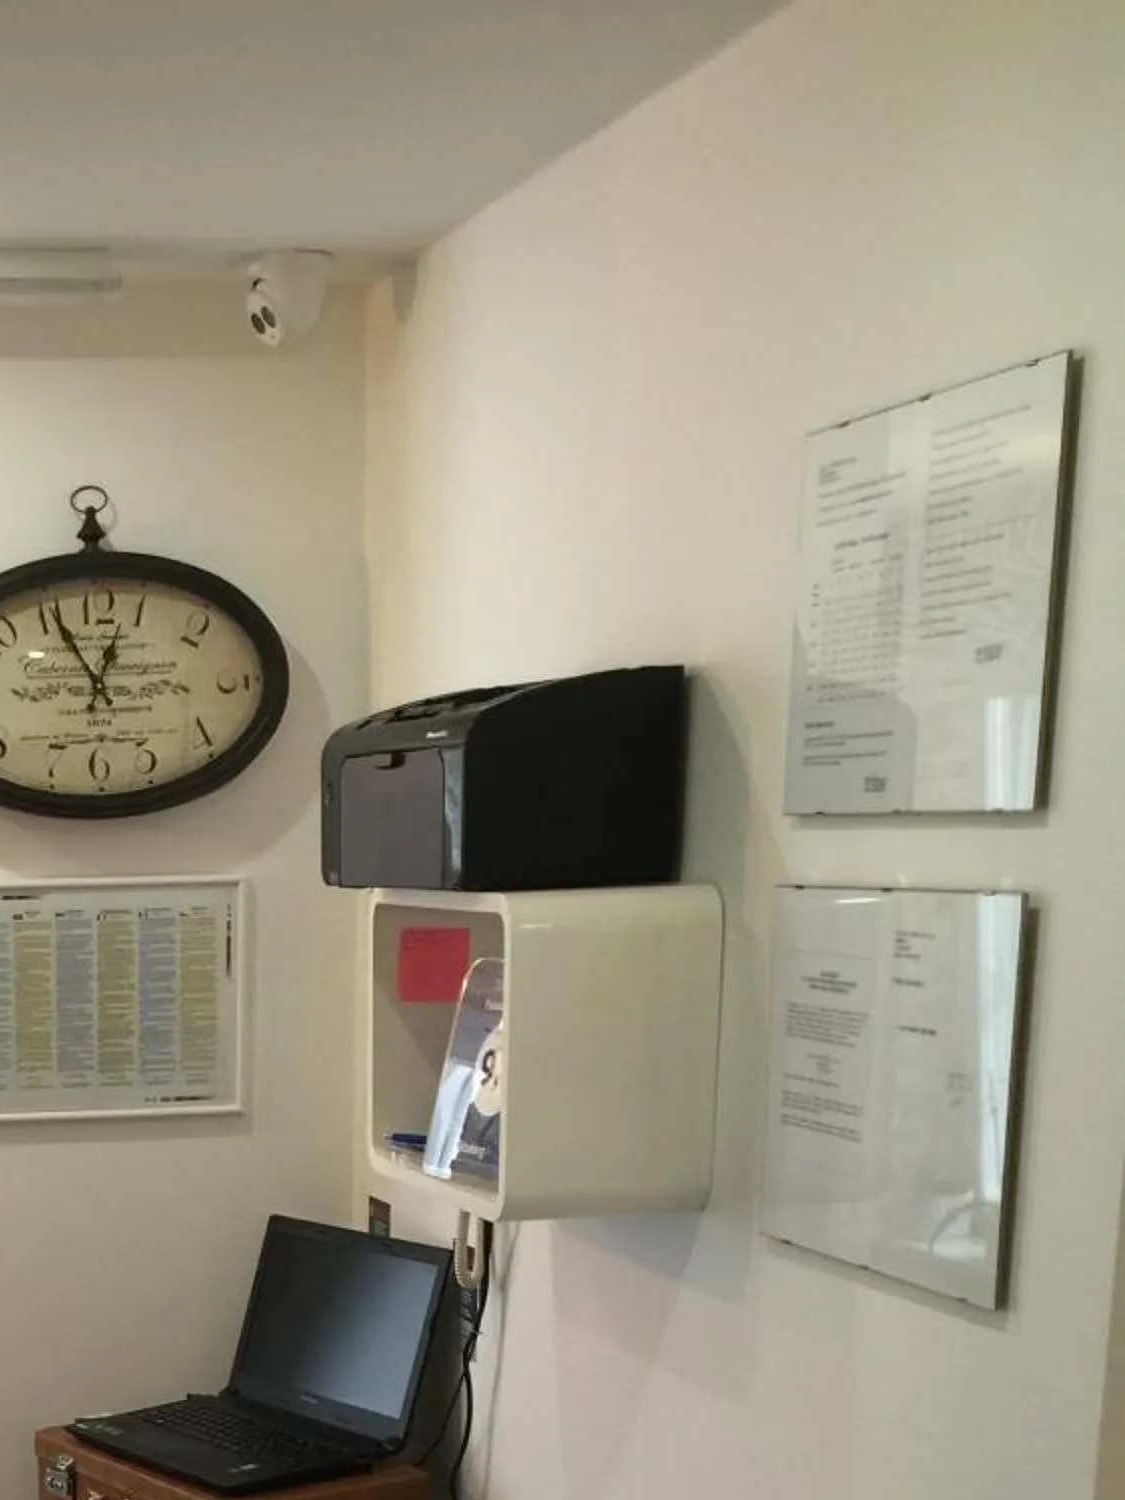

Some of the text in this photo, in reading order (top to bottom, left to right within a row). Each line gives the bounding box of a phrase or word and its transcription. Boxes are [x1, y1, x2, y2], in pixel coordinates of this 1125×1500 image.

[83, 588, 115, 625] 12
[132, 594, 146, 628] 1
[179, 610, 210, 650] 2
[45, 742, 69, 779] 7
[88, 747, 111, 782] 6
